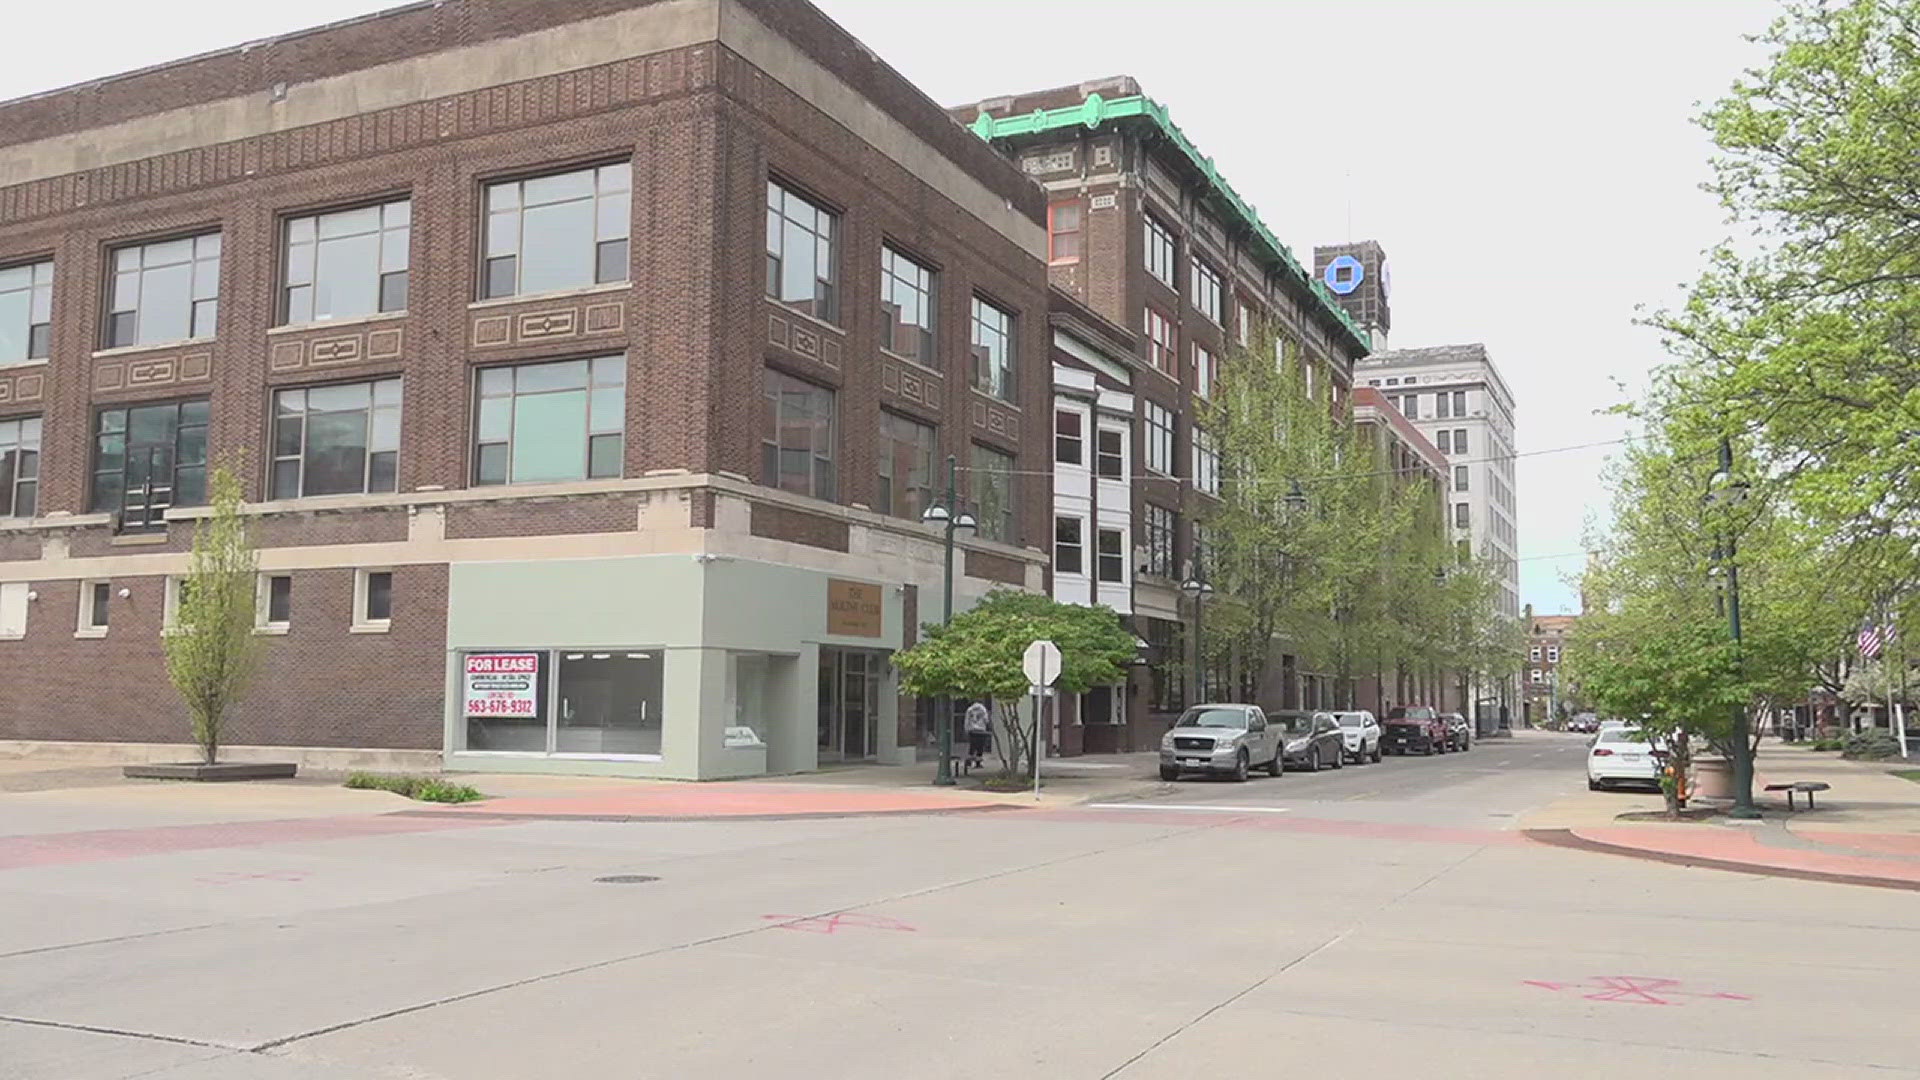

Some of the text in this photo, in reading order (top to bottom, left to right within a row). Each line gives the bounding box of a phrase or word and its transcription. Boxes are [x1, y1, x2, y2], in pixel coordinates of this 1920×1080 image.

[848, 588, 863, 600] THE
[468, 658, 533, 671] FOR LEASE
[468, 699, 532, 713] 563-676-9312
